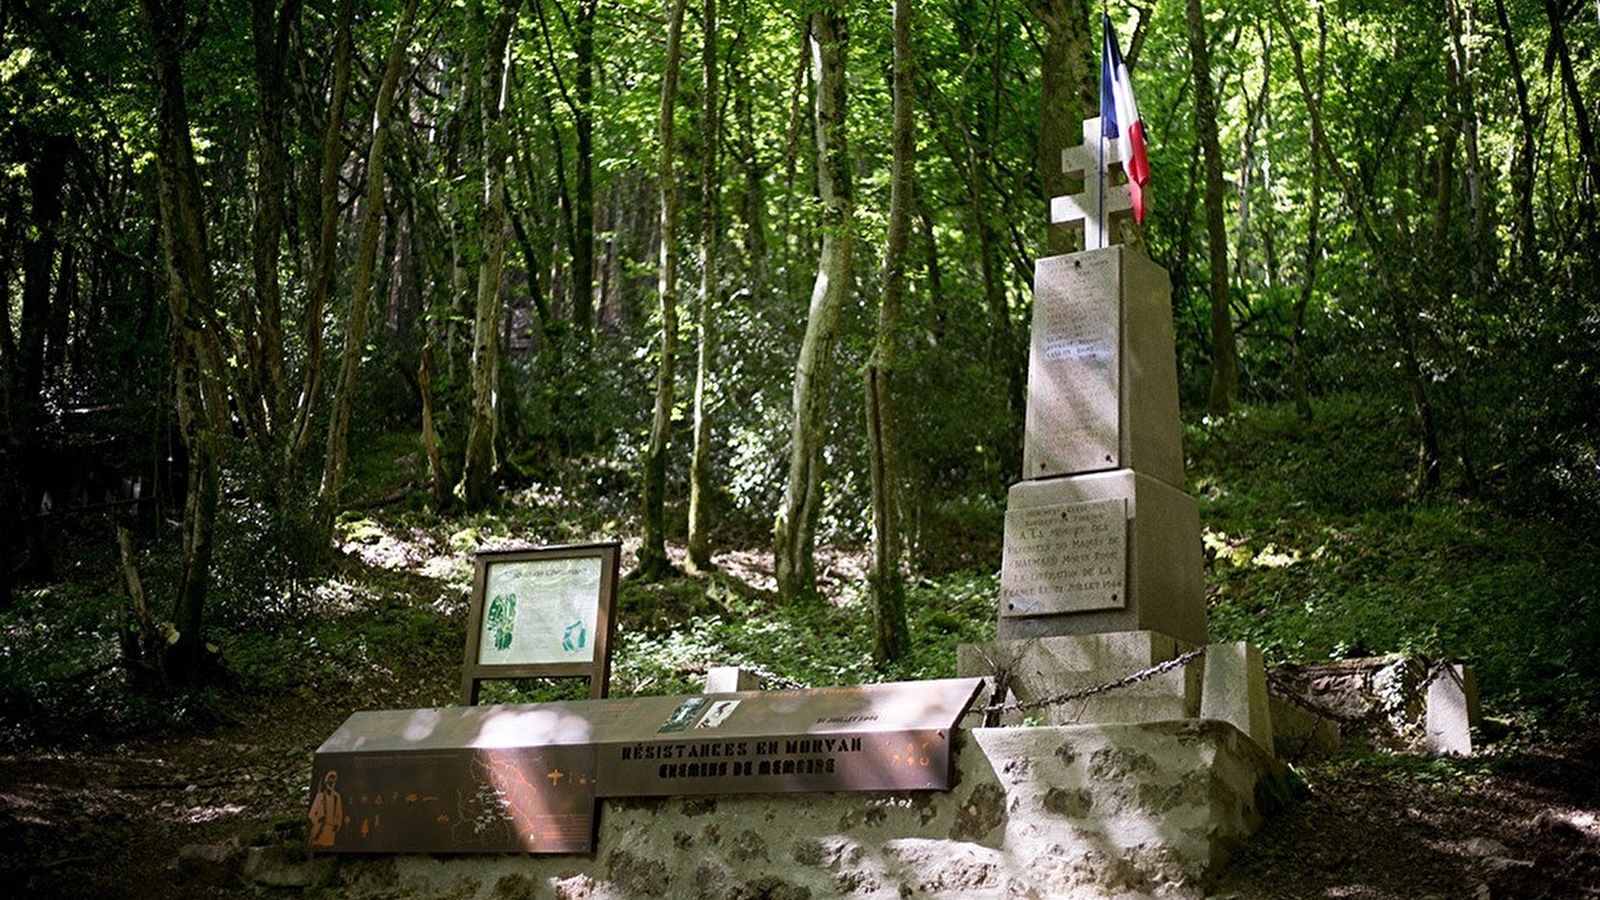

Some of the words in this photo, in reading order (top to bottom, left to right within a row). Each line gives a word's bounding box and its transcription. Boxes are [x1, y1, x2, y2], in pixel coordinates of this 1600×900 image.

[621, 742, 749, 761] RÉSISTANCES
[756, 740, 779, 756] EN
[785, 737, 862, 755] MORVAN
[658, 761, 728, 778] CHEMINS
[733, 760, 749, 776] DE
